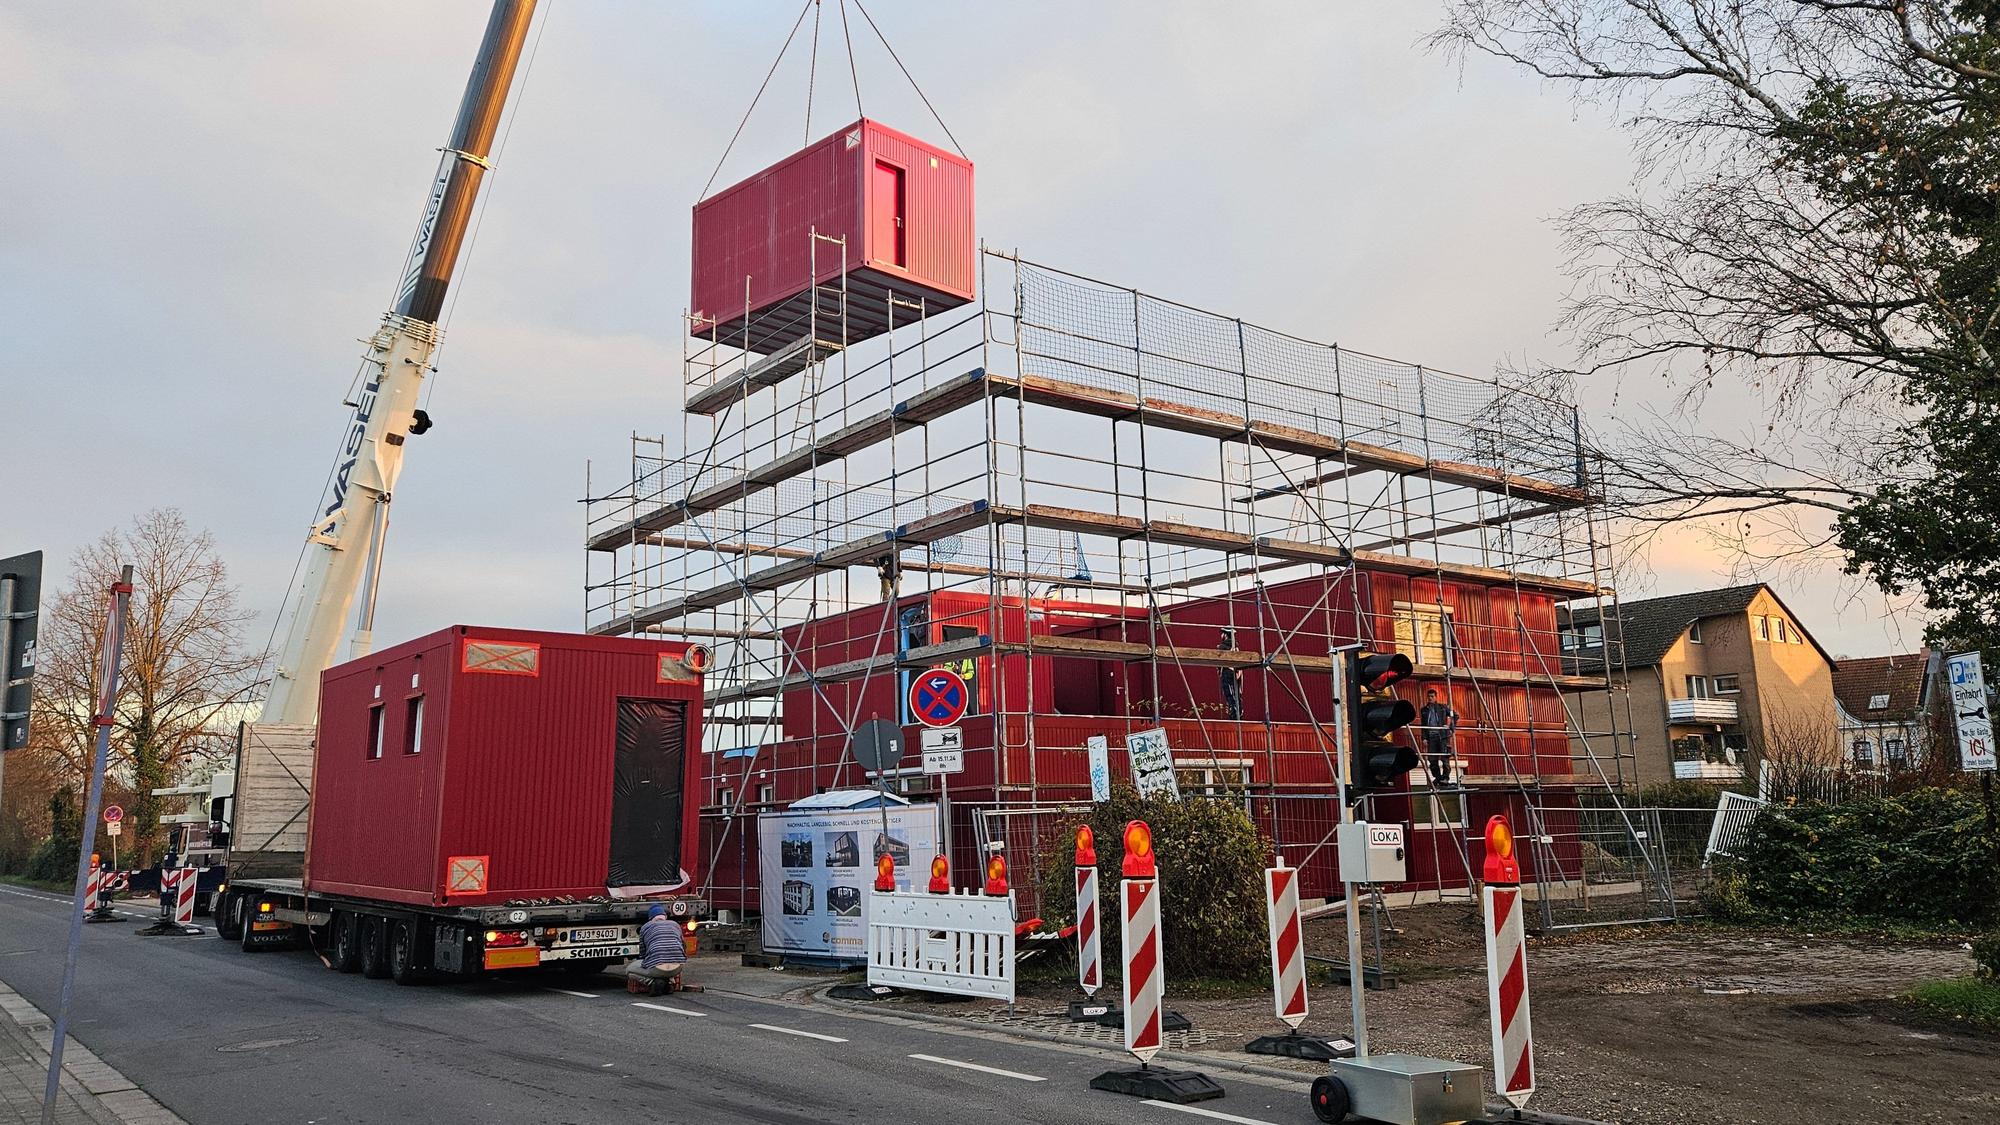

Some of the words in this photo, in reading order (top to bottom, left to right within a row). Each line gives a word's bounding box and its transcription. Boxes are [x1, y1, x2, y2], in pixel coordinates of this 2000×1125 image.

[415, 169, 450, 258] WASEL
[1955, 688, 1983, 700] Einfahrt
[674, 902, 685, 912] 90
[513, 912, 523, 921] CZ
[577, 931, 591, 939] 5J3
[595, 930, 614, 939] 9403
[831, 936, 863, 945] comma
[570, 947, 621, 959] SCHMITZ
